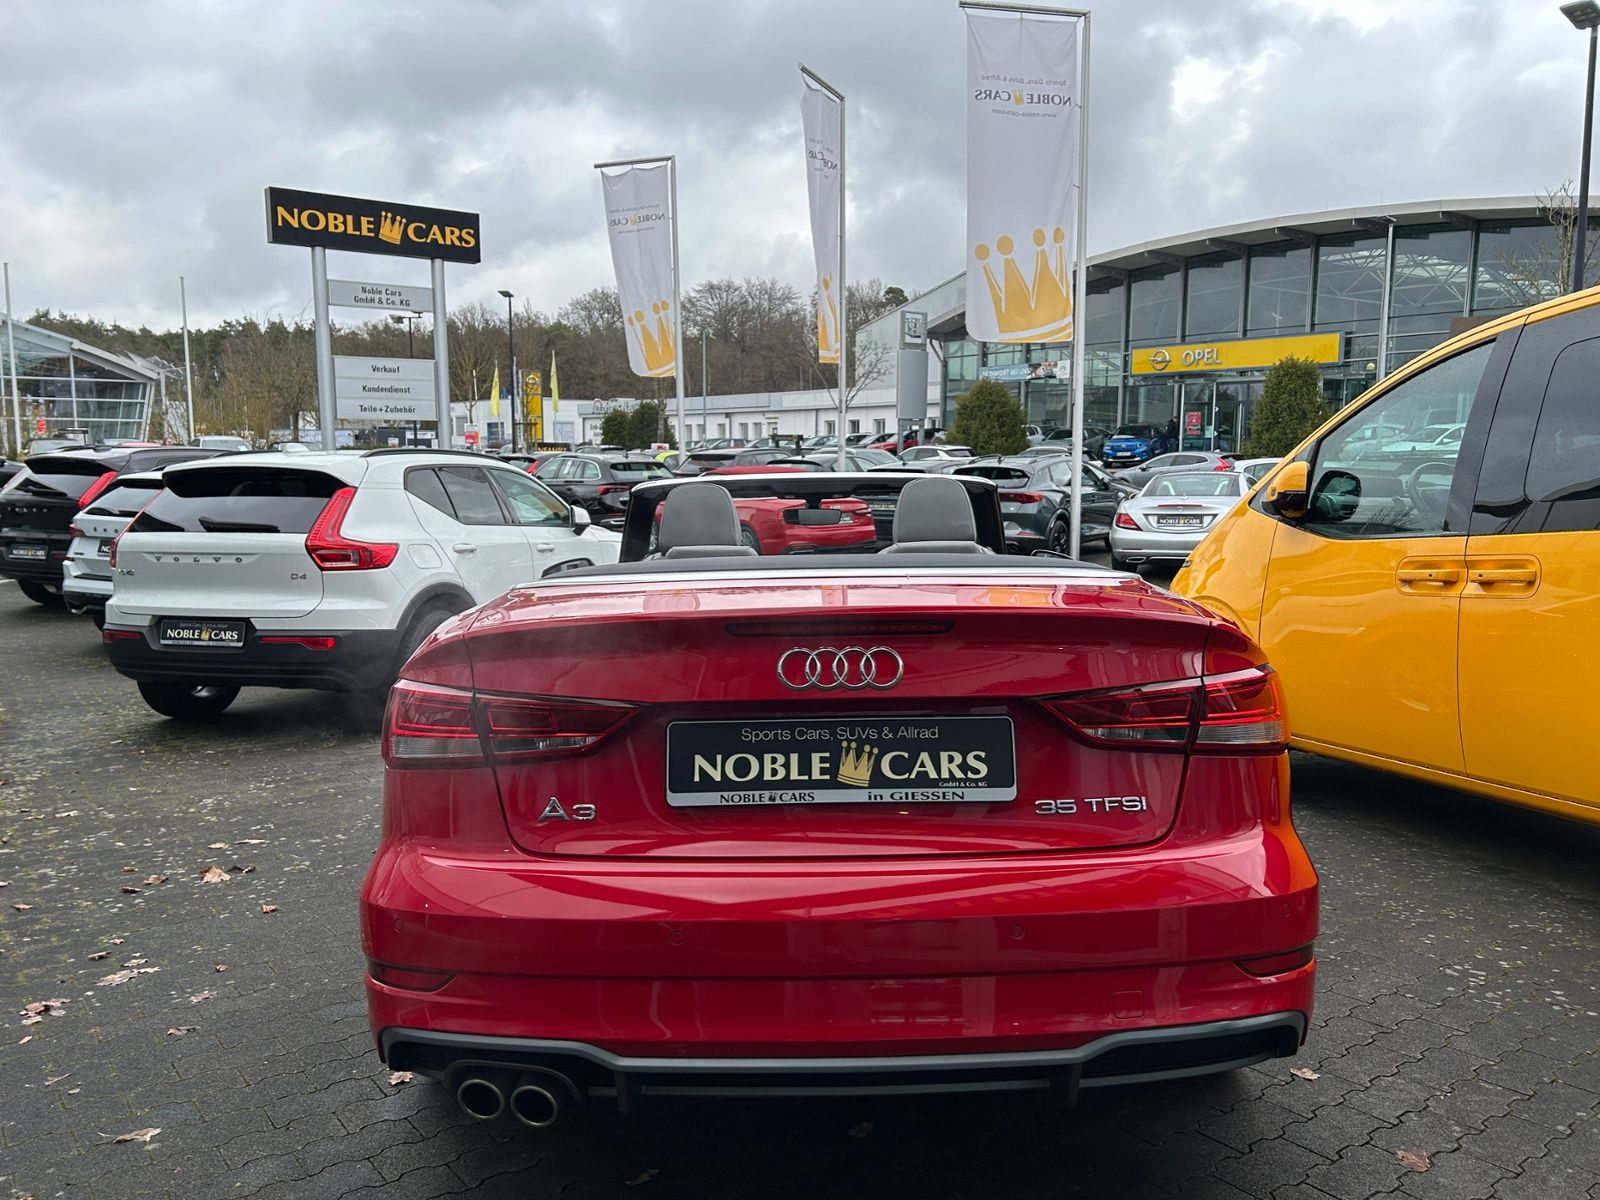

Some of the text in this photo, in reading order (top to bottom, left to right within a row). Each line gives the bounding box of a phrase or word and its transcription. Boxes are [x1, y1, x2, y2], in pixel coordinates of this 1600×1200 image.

[276, 206, 476, 248] NOBLE CARS
[361, 286, 402, 296] Noble Cars
[354, 295, 375, 304] GmbH
[386, 298, 398, 306] Co.
[400, 299, 411, 307] KG
[1182, 348, 1221, 366] OPEL
[371, 364, 400, 373] Verkauf
[362, 384, 410, 393] Kundendienst
[154, 555, 243, 564] VOLVO
[166, 629, 239, 640] NOBLE CARS
[741, 726, 939, 743] Sports Cars, SUVs & Allrad
[693, 751, 988, 782] NOBLE CARS
[720, 792, 816, 804] NOBLE CARS
[868, 791, 965, 801] in GIESSEN
[538, 796, 596, 821] A3
[1035, 796, 1147, 814] 35 TFSI
